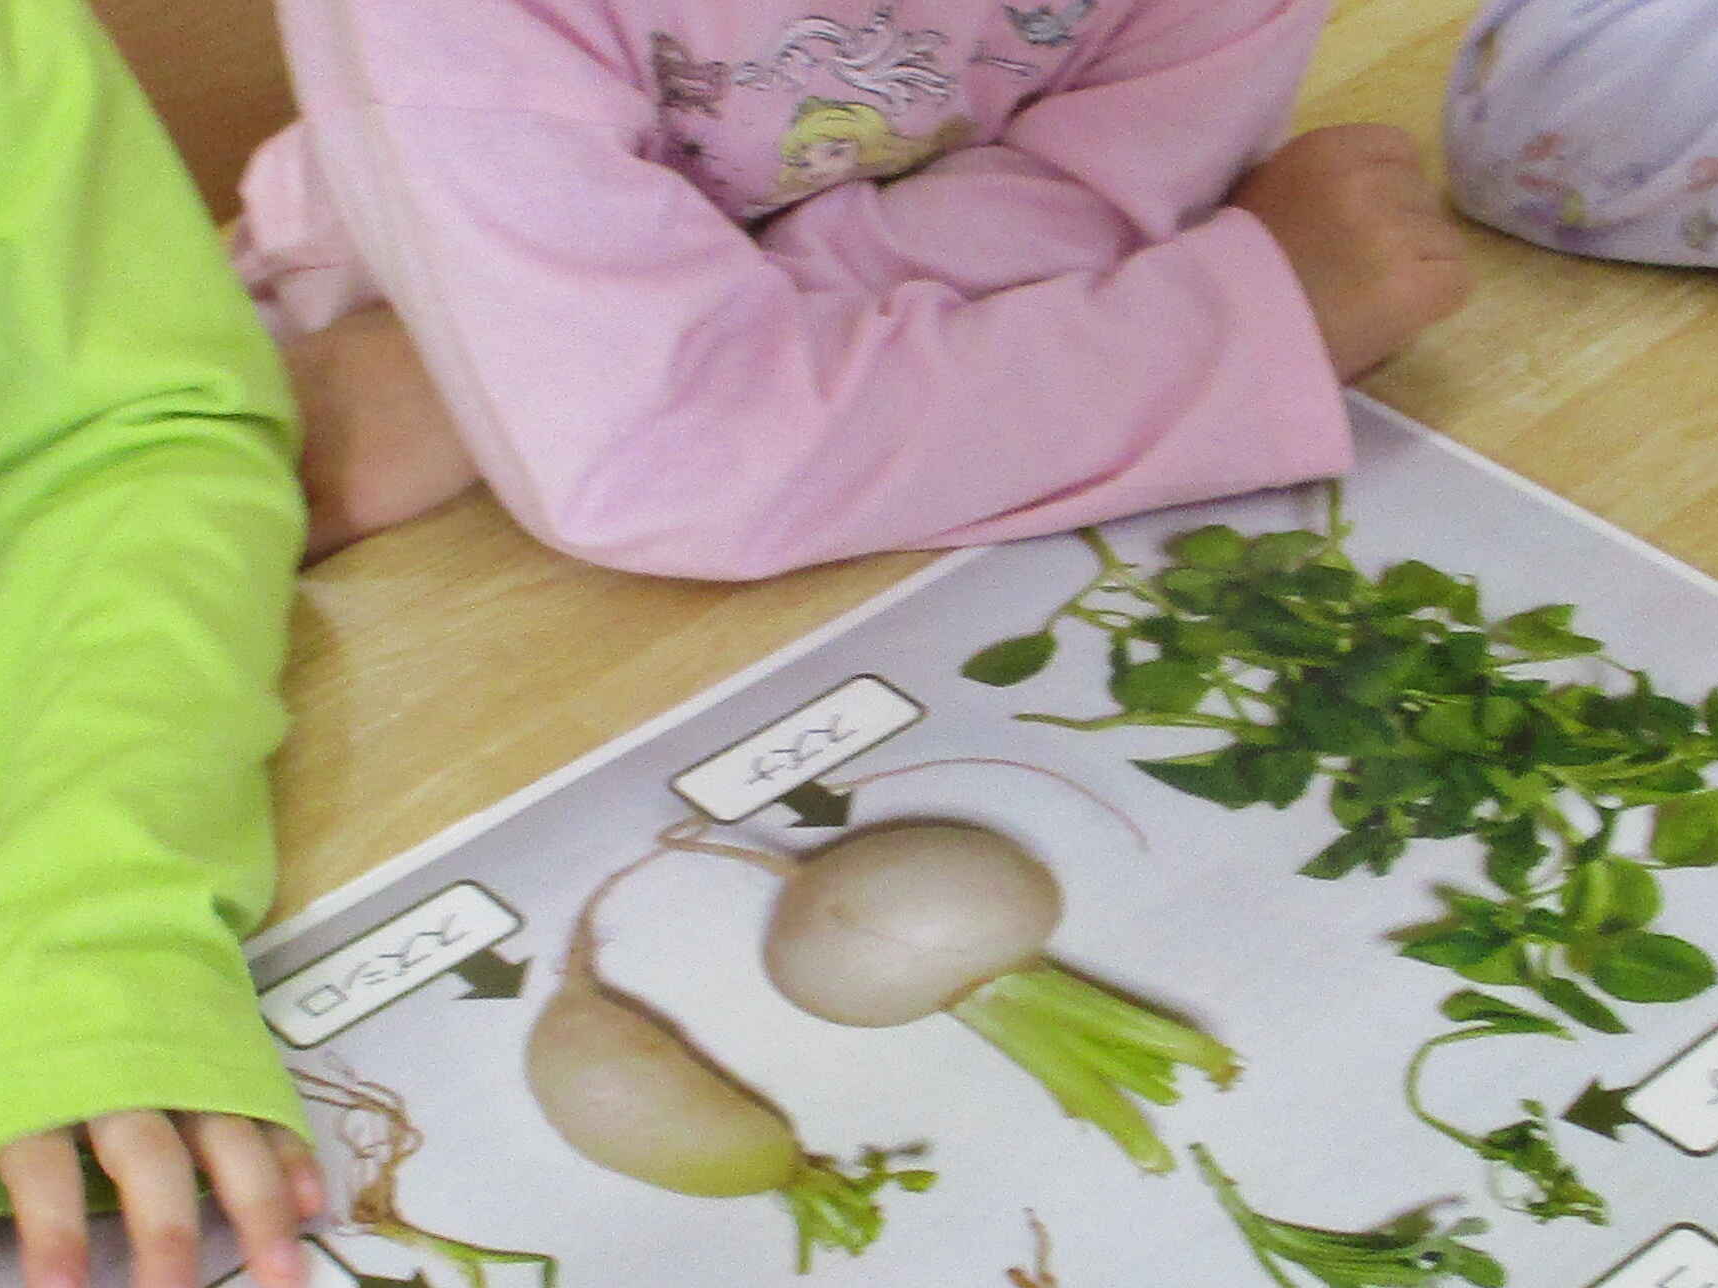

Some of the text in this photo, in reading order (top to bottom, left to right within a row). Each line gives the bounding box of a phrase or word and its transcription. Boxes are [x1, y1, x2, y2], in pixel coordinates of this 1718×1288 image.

[747, 712, 859, 786] スズナ
[295, 913, 475, 1018] スズシロ
